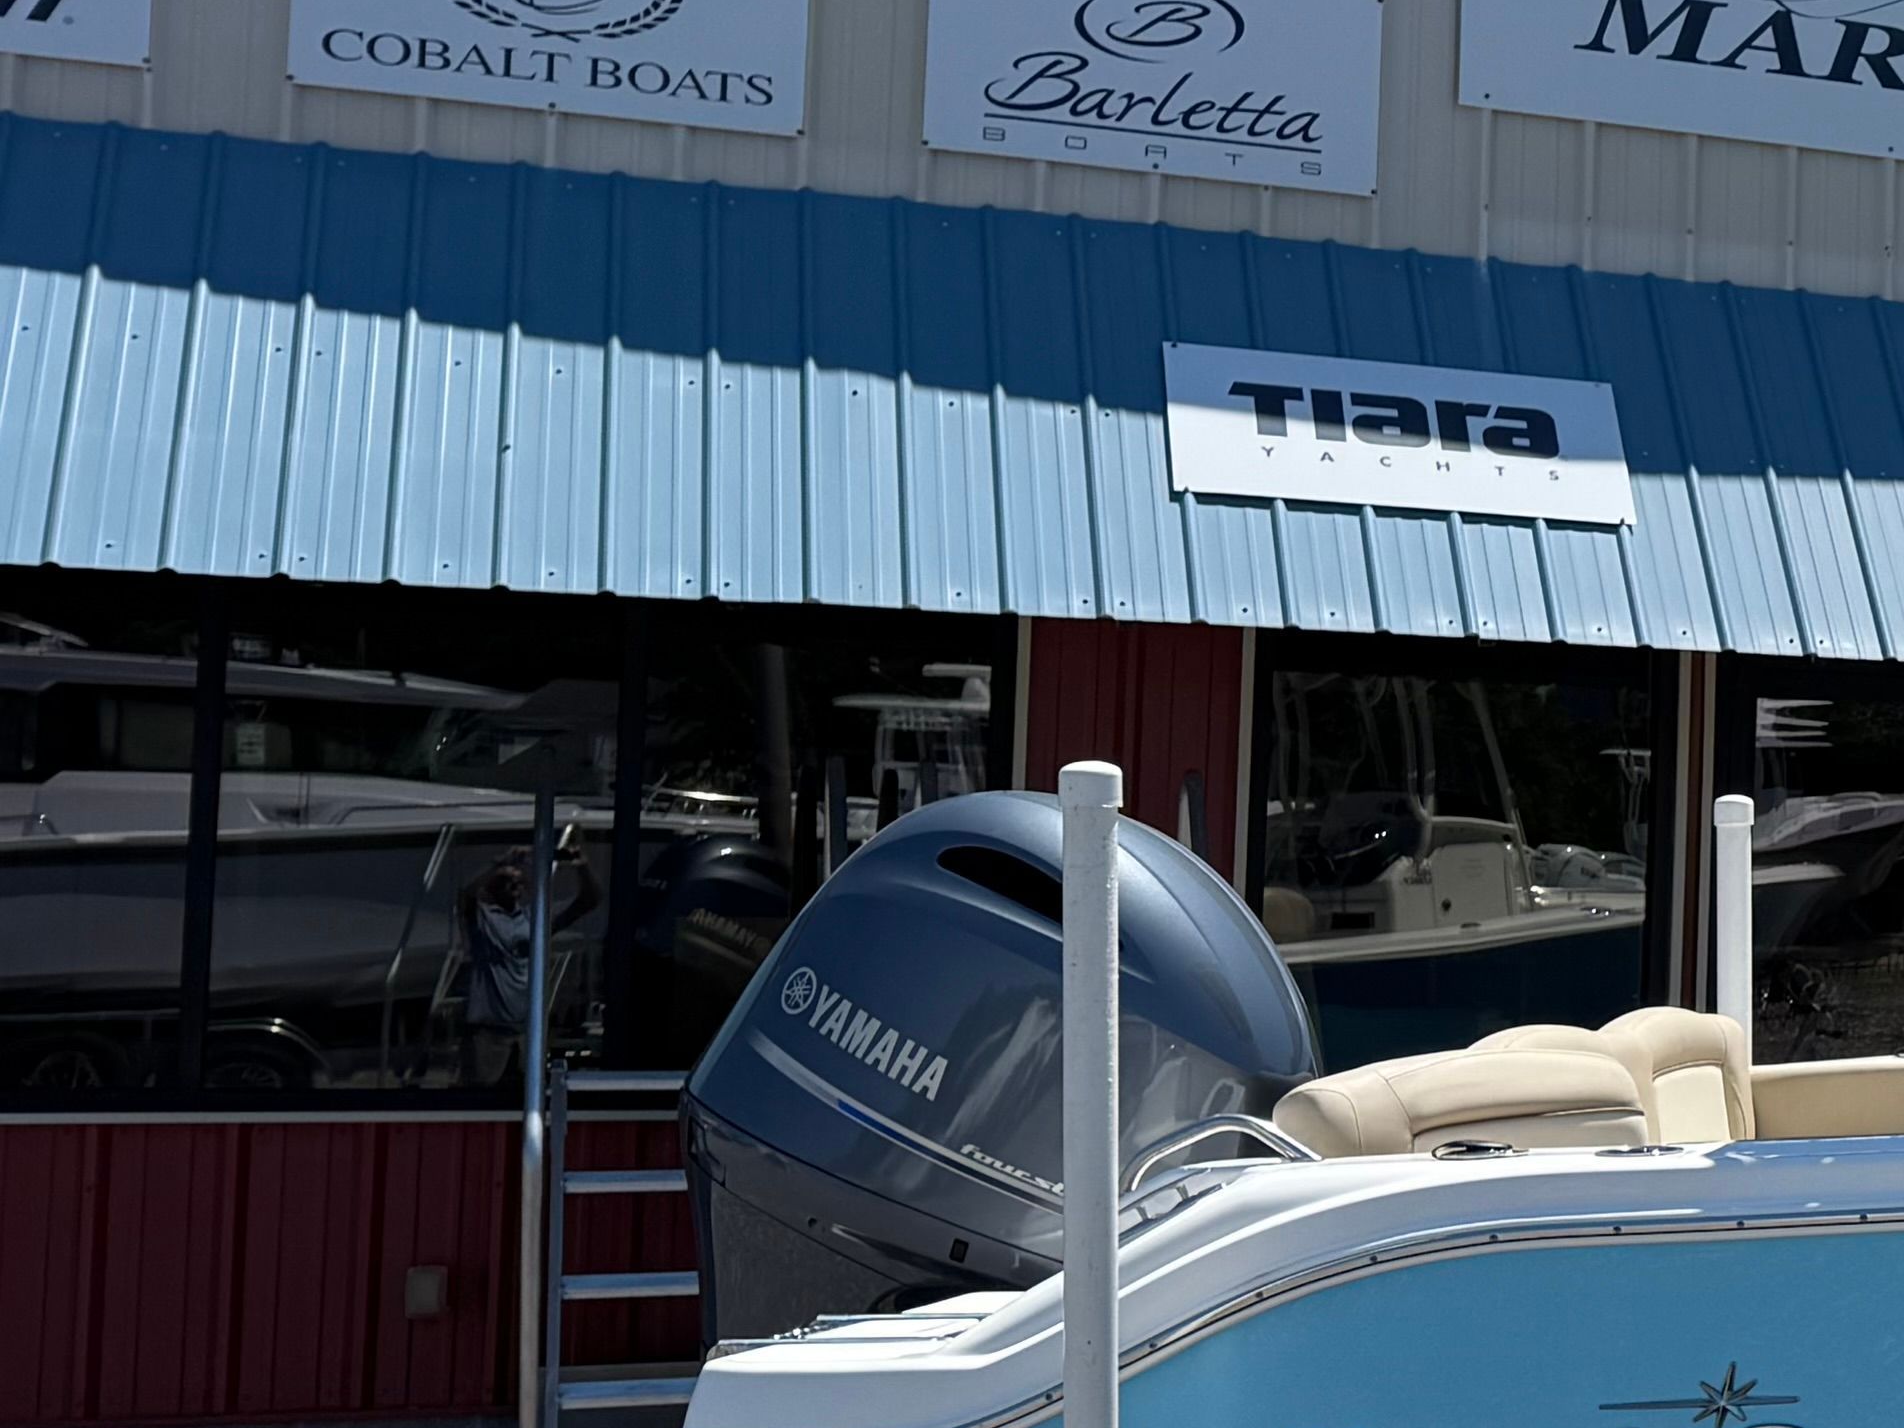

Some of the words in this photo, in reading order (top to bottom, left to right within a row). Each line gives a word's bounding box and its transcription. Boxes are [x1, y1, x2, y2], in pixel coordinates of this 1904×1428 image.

[321, 27, 572, 85] COBALT
[587, 56, 775, 107] BOATS
[984, 51, 1323, 143] Barletta
[983, 126, 1322, 176] BOATS
[1261, 445, 1560, 482] YACHTS
[808, 983, 950, 1102] YAMAHA
